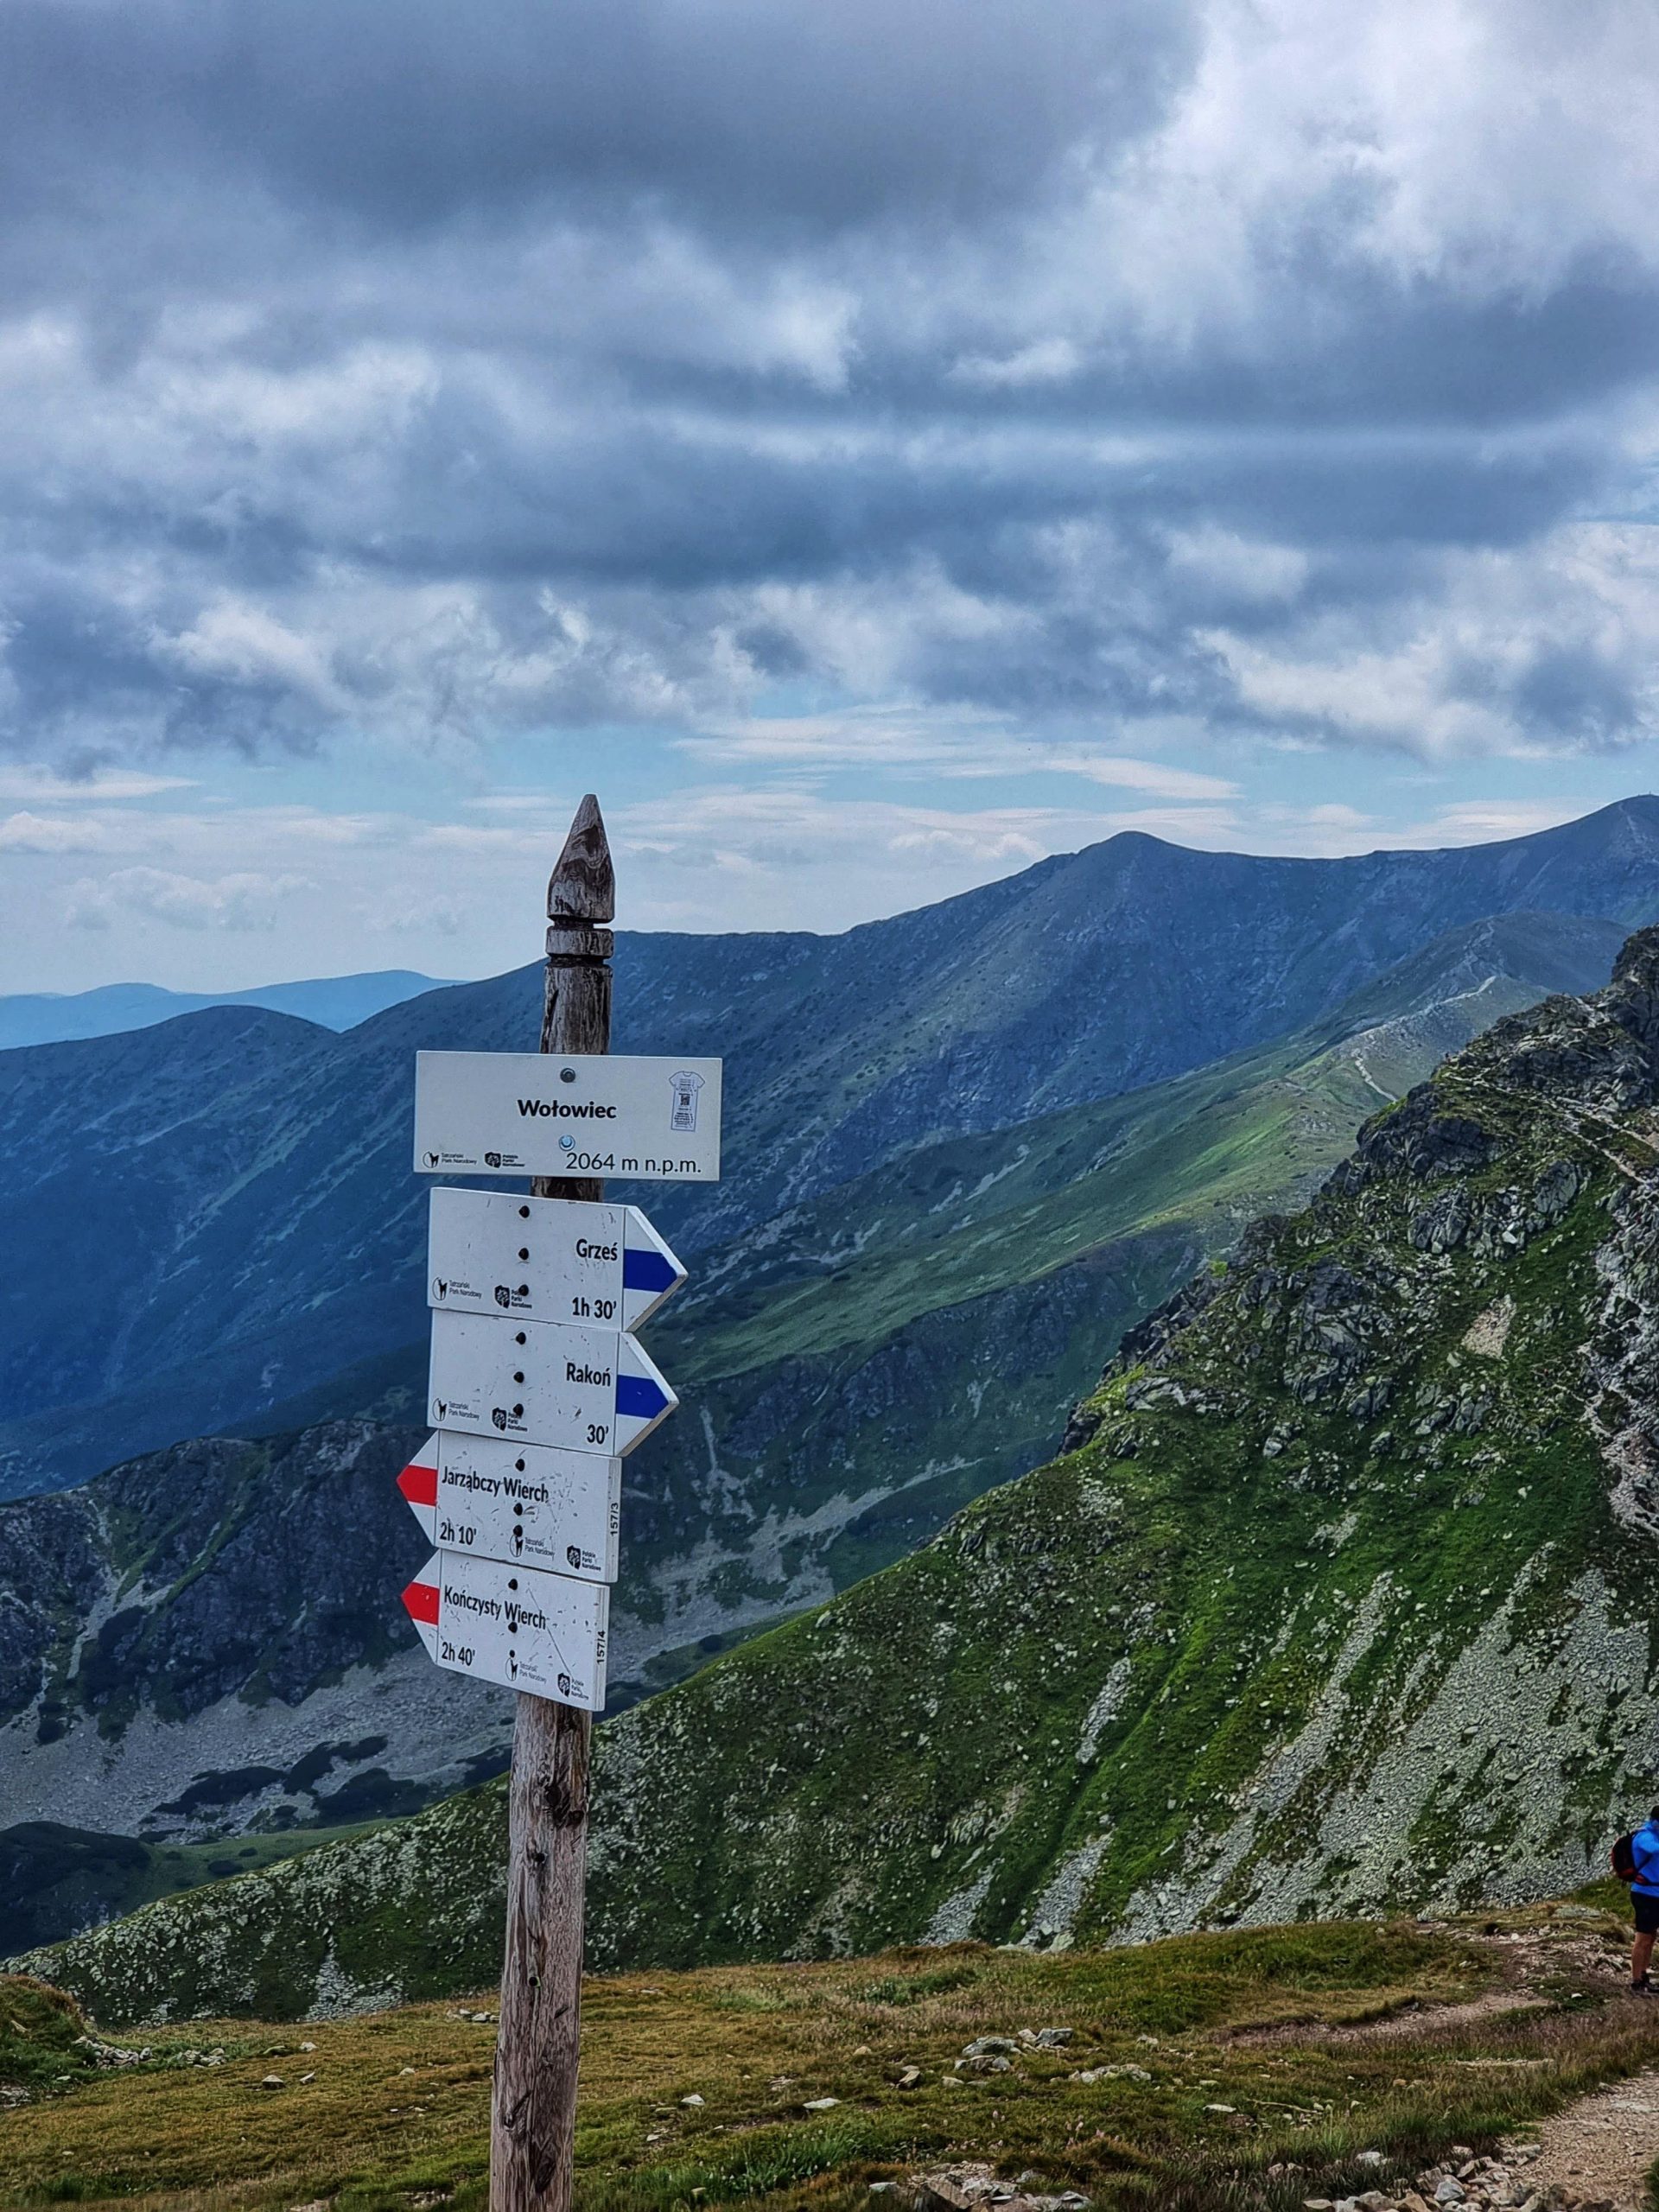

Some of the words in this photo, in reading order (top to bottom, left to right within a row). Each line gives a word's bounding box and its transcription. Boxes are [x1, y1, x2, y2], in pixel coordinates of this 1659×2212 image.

[518, 1099, 617, 1119] Wołowiec
[566, 1152, 616, 1171] 2064
[621, 1157, 639, 1171] m
[645, 1158, 702, 1175] n.p.m.
[576, 1238, 618, 1261] Grześ
[572, 1297, 590, 1317] 1h
[594, 1300, 617, 1319] 30'
[566, 1362, 611, 1387] Rakoń
[587, 1424, 608, 1445] 30'
[442, 1465, 500, 1497] Jarząbczy
[503, 1477, 549, 1503] Wierch
[610, 1503, 619, 1536] 157/3
[439, 1522, 454, 1541] 2h
[458, 1525, 477, 1545] 10'
[444, 1584, 502, 1621] Kończysty
[505, 1600, 546, 1630] Wierch
[442, 1642, 455, 1662] 2h
[458, 1647, 475, 1666] 40'
